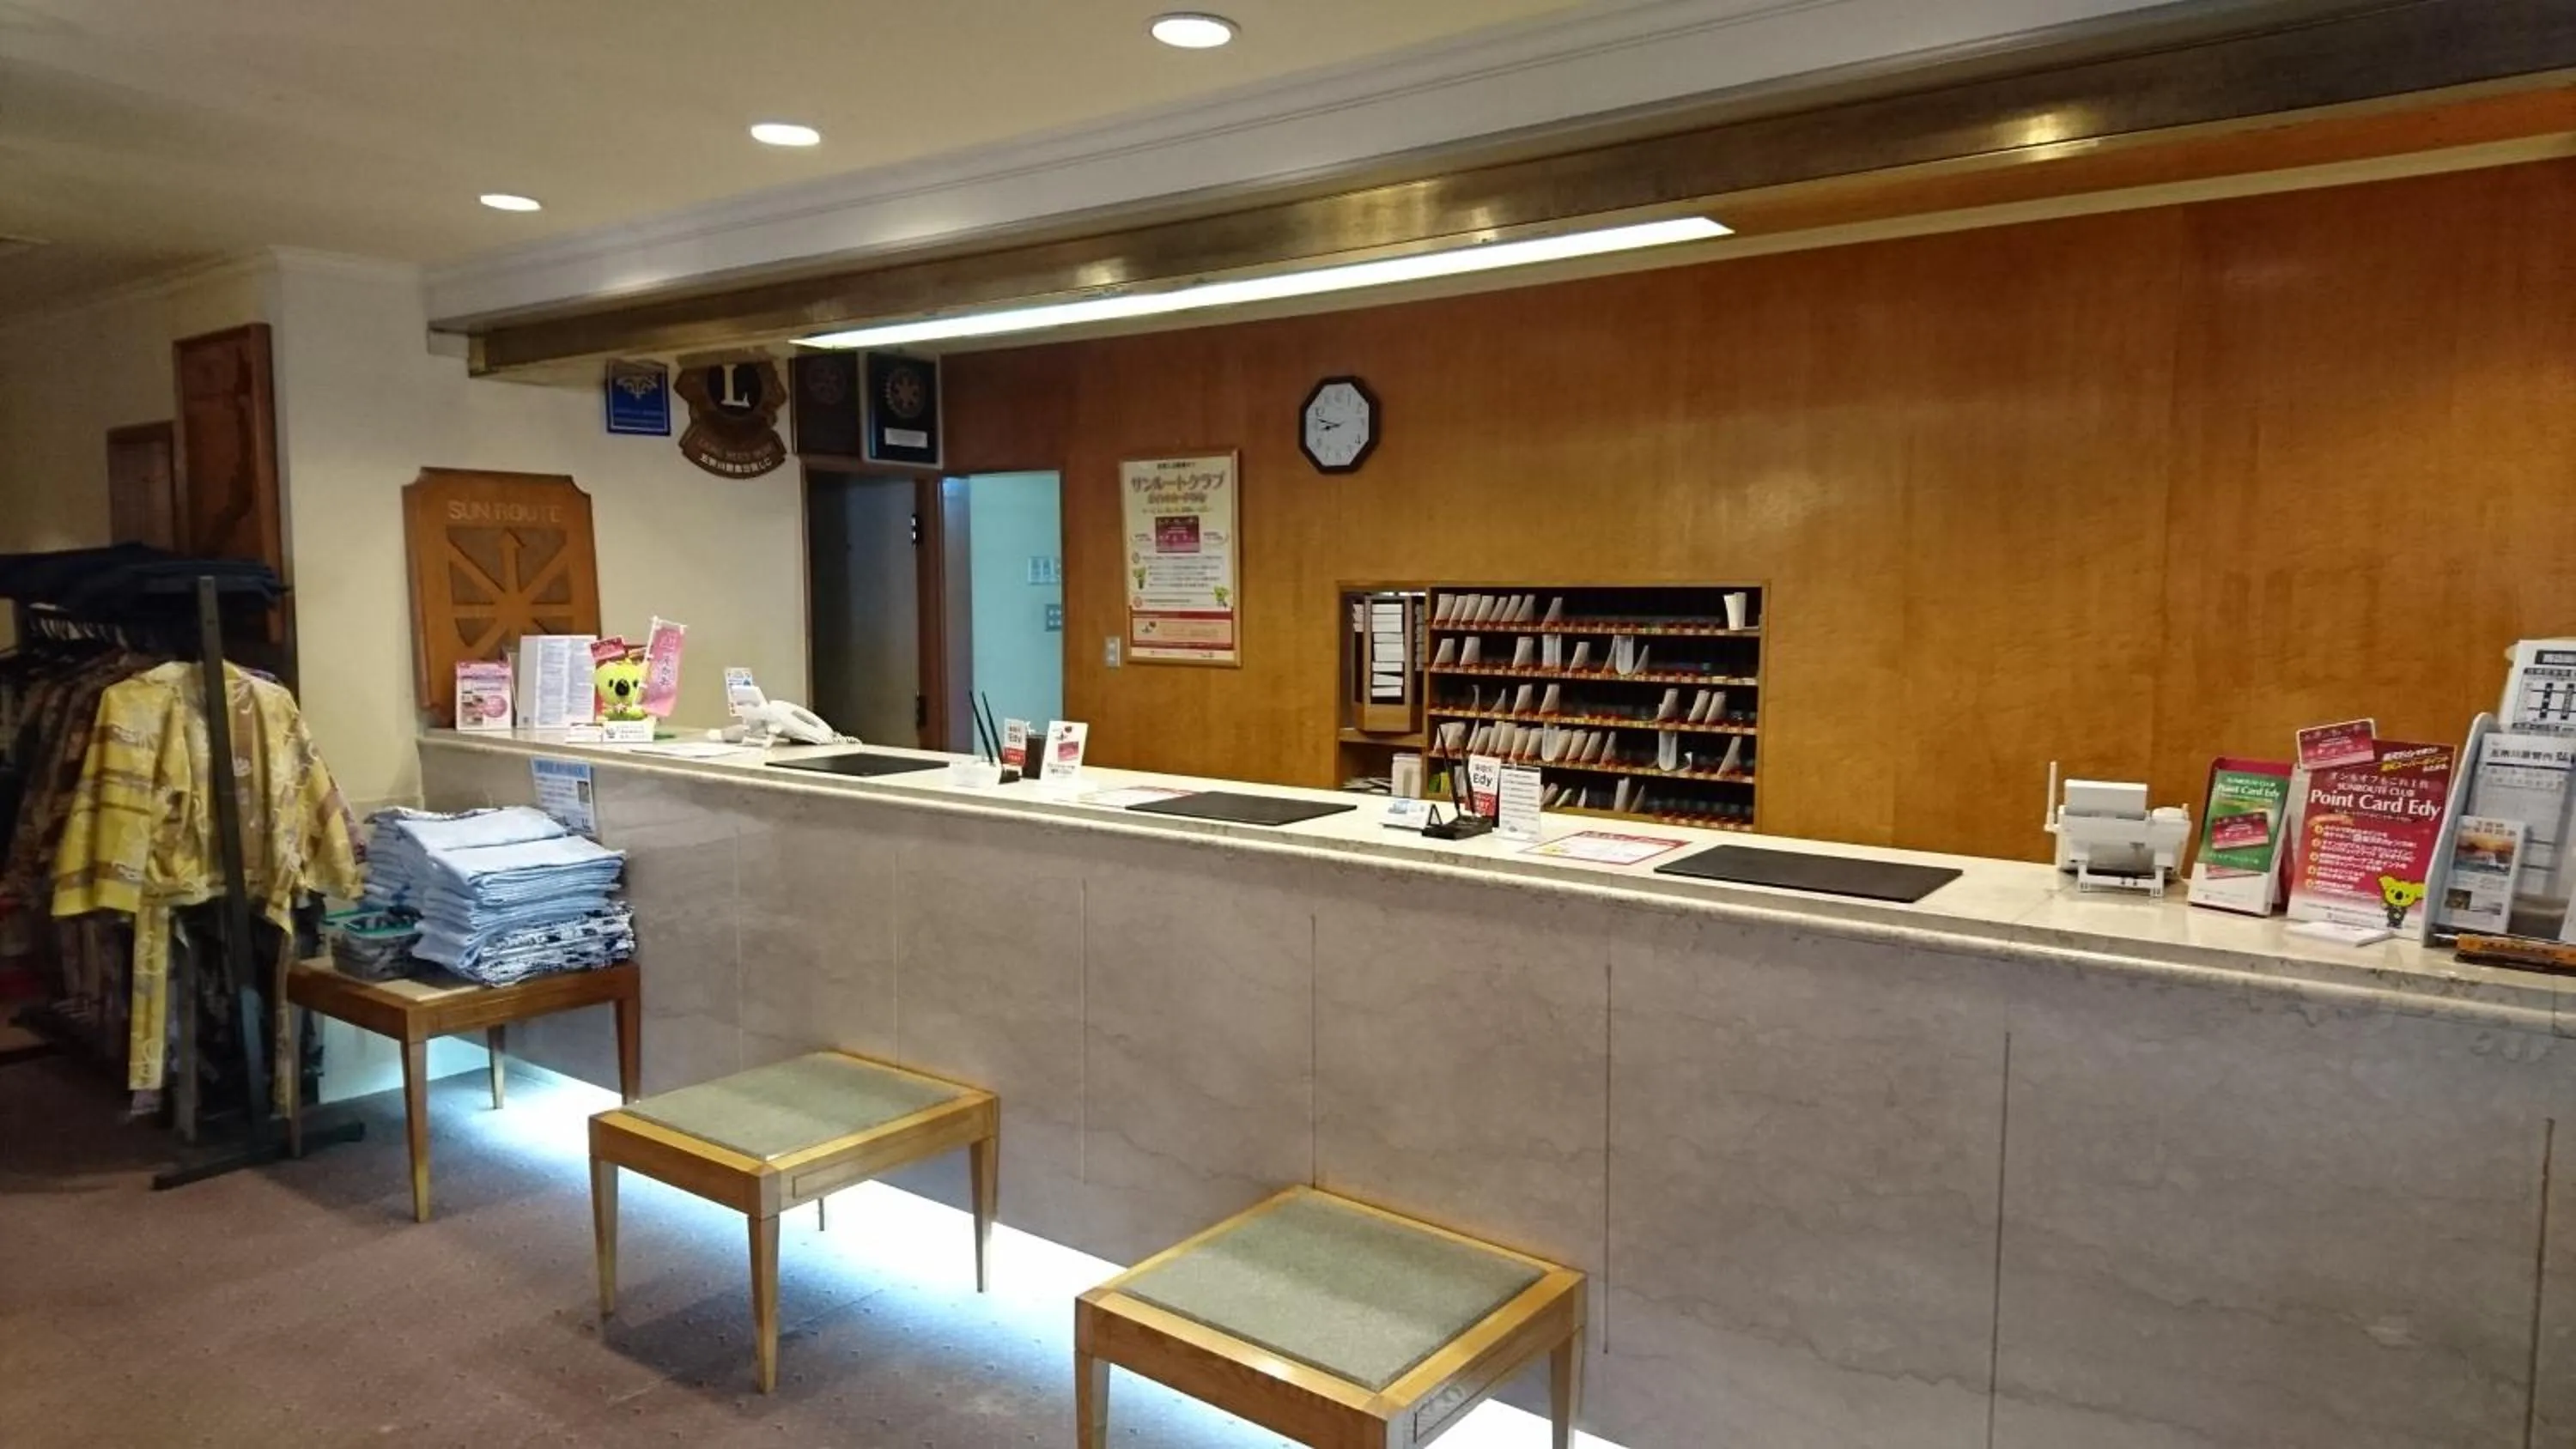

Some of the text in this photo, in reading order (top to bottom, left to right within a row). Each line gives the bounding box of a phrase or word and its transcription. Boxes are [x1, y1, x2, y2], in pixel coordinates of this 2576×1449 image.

[720, 364, 750, 408] L
[447, 499, 563, 523] SUN ROUTE
[1473, 773, 1492, 787] Edy
[2310, 789, 2354, 808] Point
[2359, 794, 2404, 814] Card
[2408, 799, 2442, 822] Edy
